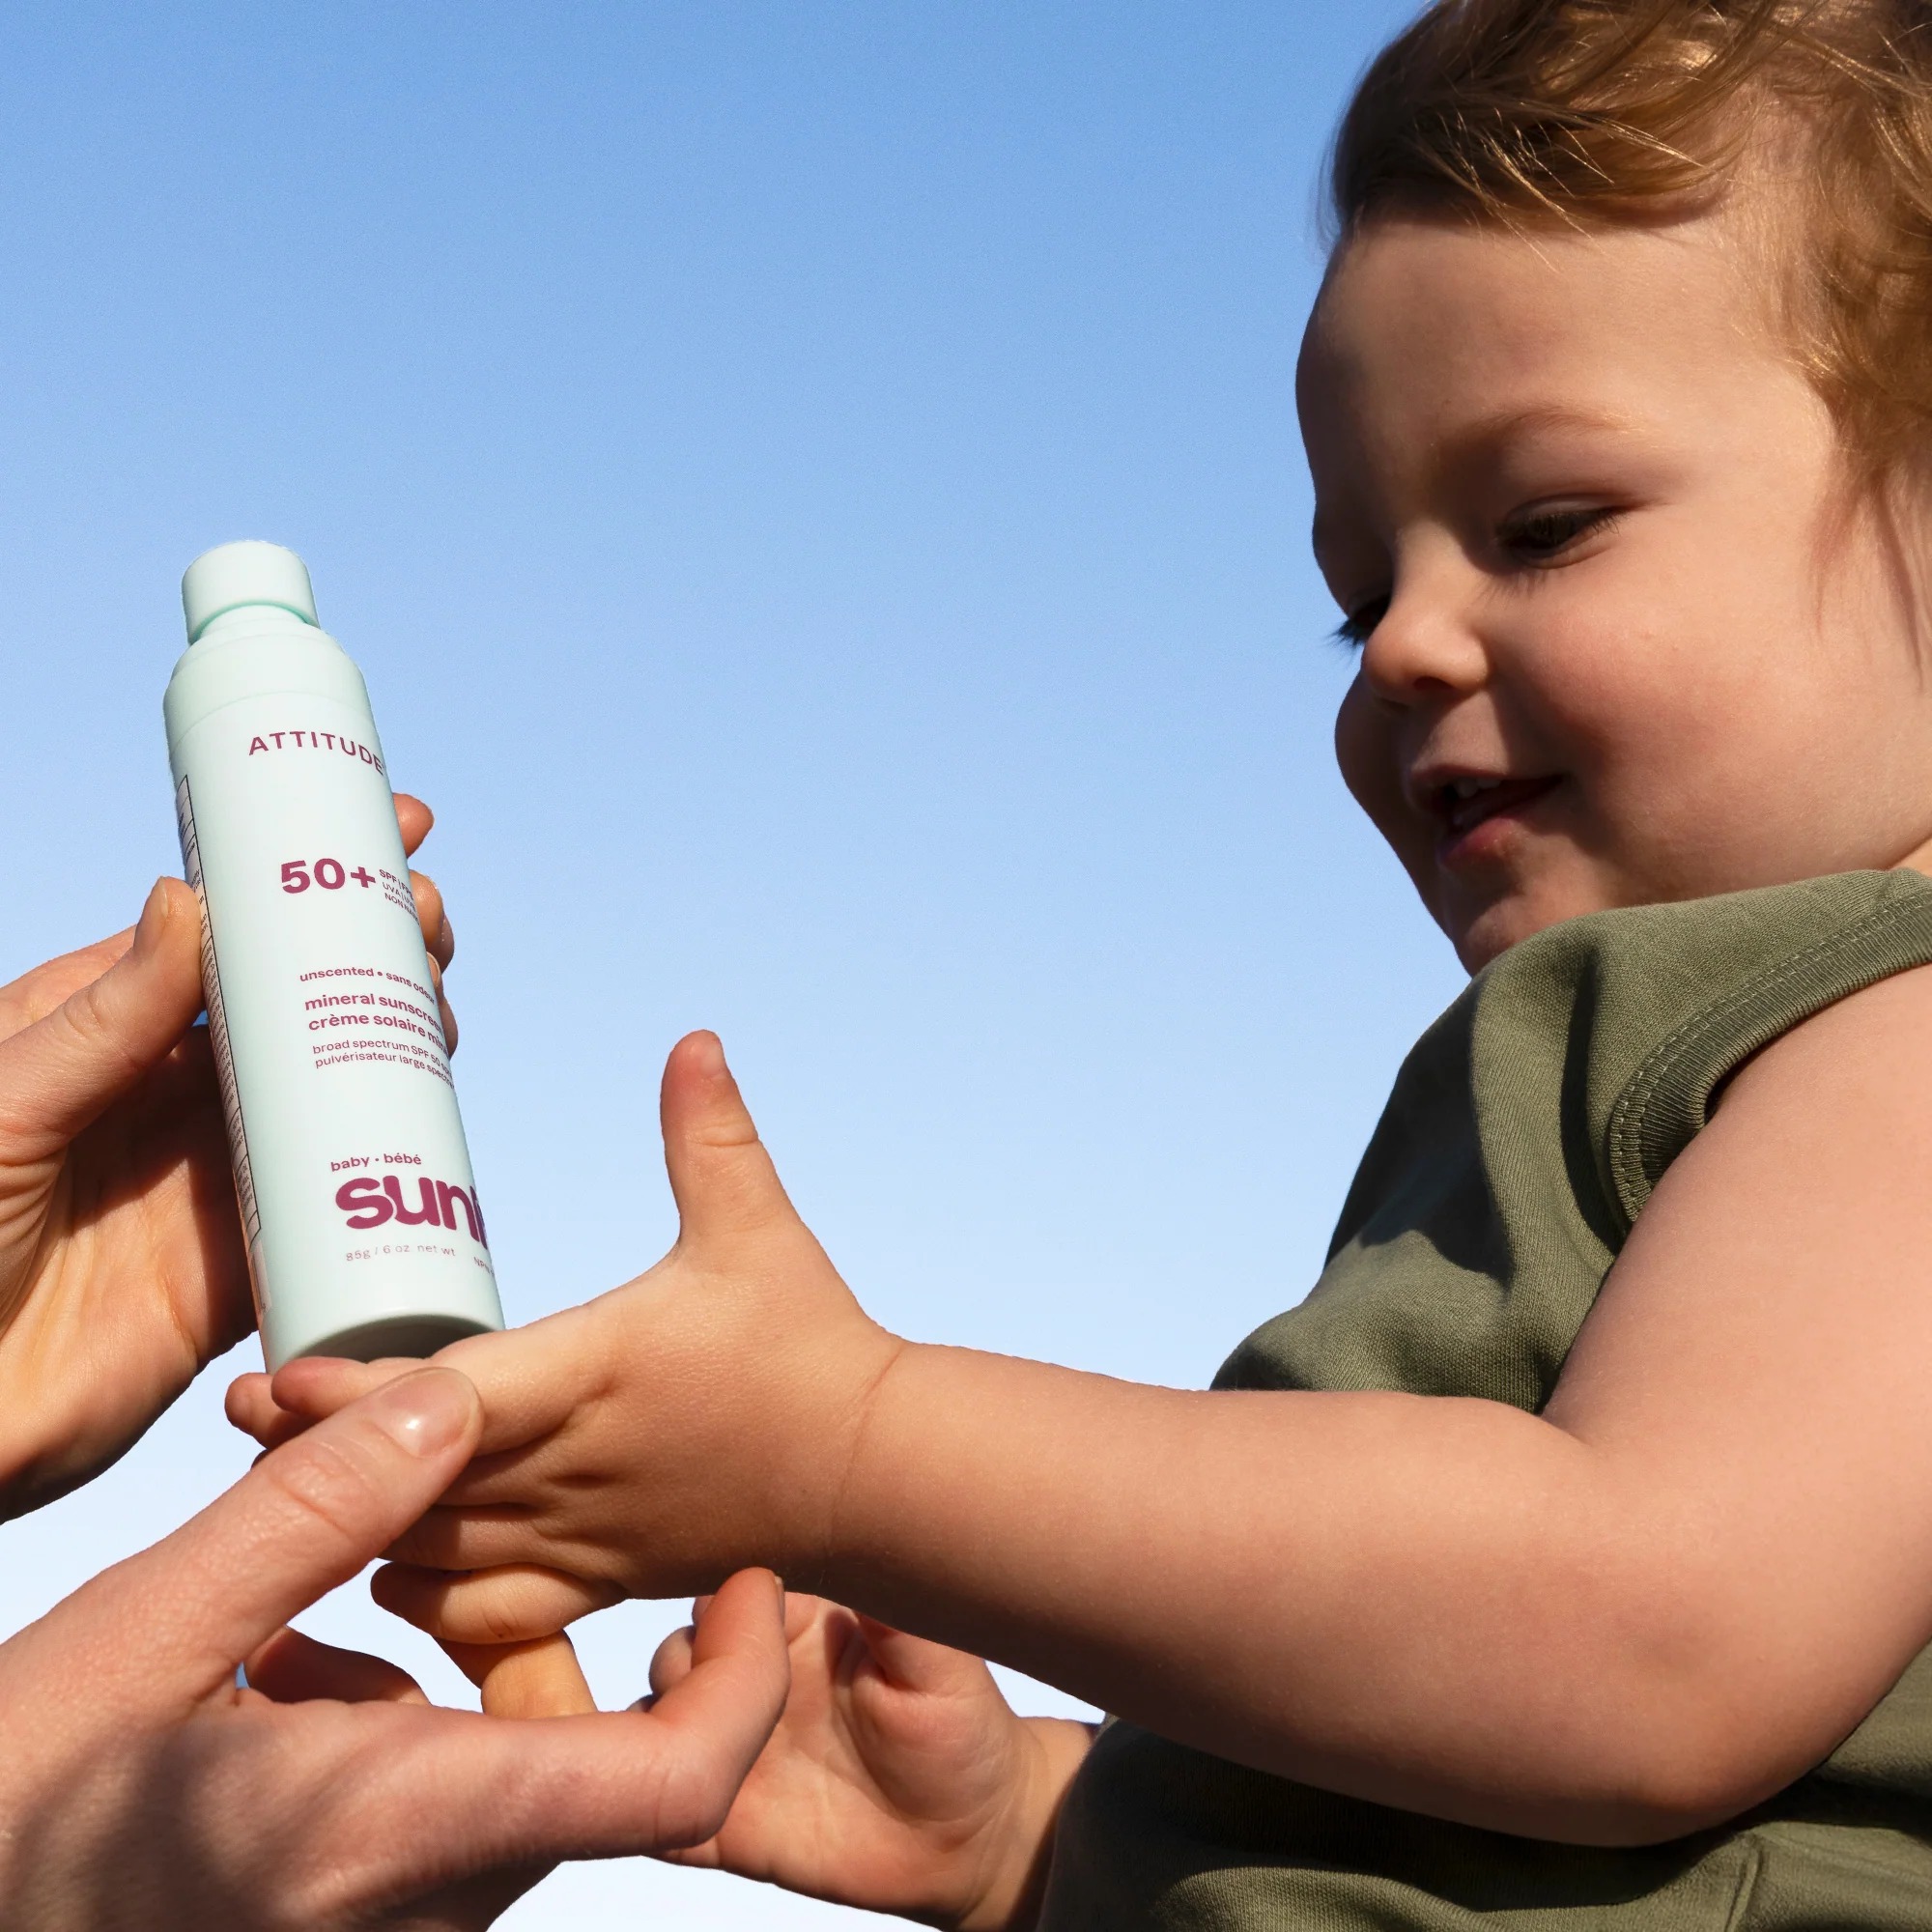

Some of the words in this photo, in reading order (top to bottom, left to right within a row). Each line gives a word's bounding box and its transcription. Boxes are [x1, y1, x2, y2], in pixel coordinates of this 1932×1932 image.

[249, 731, 384, 776] ATTITUDE
[281, 858, 376, 894] 50+
[379, 868, 397, 883] SPF
[299, 967, 374, 981] unscented
[385, 972, 412, 987] sans
[304, 993, 376, 1010] mineral
[308, 1014, 369, 1031] crème
[373, 1015, 426, 1037] solaire
[312, 1039, 351, 1054] broad
[353, 1039, 411, 1053] spectrum
[411, 1045, 429, 1059] SPF
[315, 1051, 397, 1068] pulvérisateur
[399, 1054, 426, 1069] large
[330, 1156, 370, 1172] baby
[384, 1152, 422, 1165] bébé
[383, 1244, 390, 1254] 6
[395, 1244, 410, 1253] oz
[417, 1244, 438, 1254] net
[440, 1247, 456, 1257] wt
